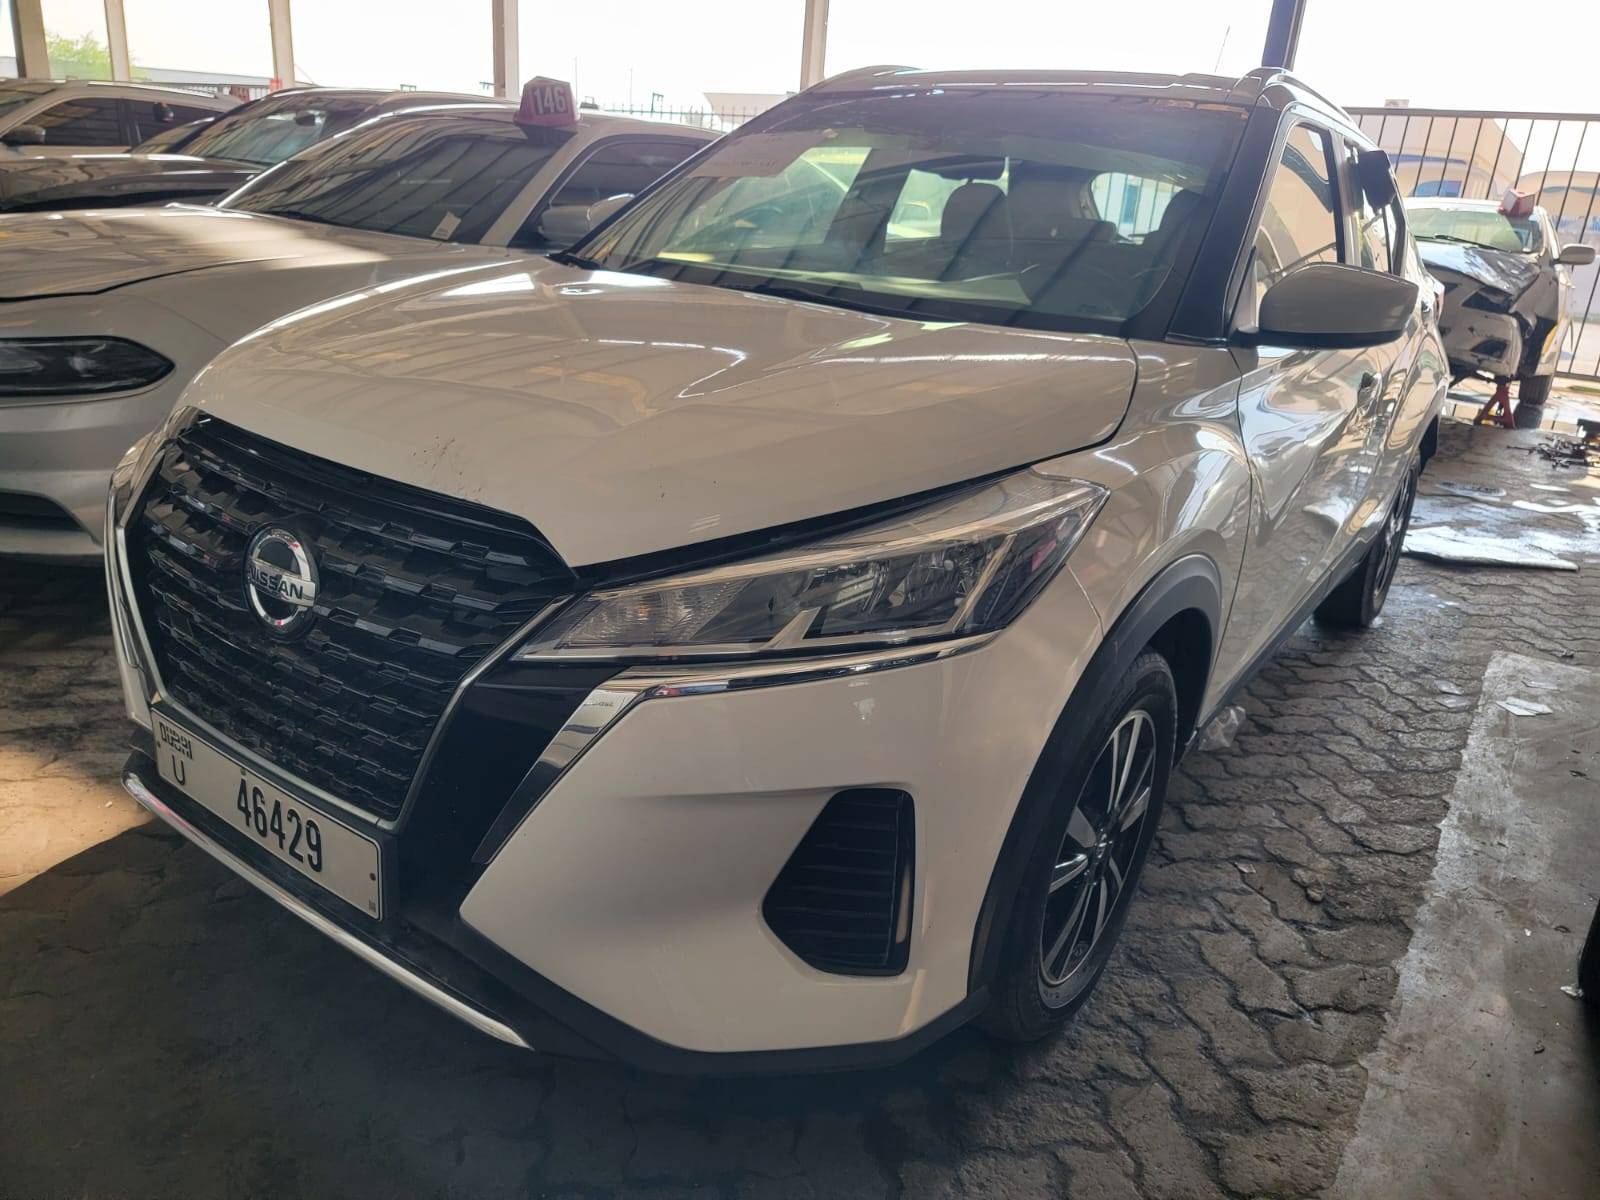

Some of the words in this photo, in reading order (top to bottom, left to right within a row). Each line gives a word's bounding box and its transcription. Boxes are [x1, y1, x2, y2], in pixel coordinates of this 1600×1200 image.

[534, 86, 566, 115] 146
[249, 567, 303, 600] NISSAN
[171, 753, 185, 786] U
[236, 778, 323, 873] 46429
